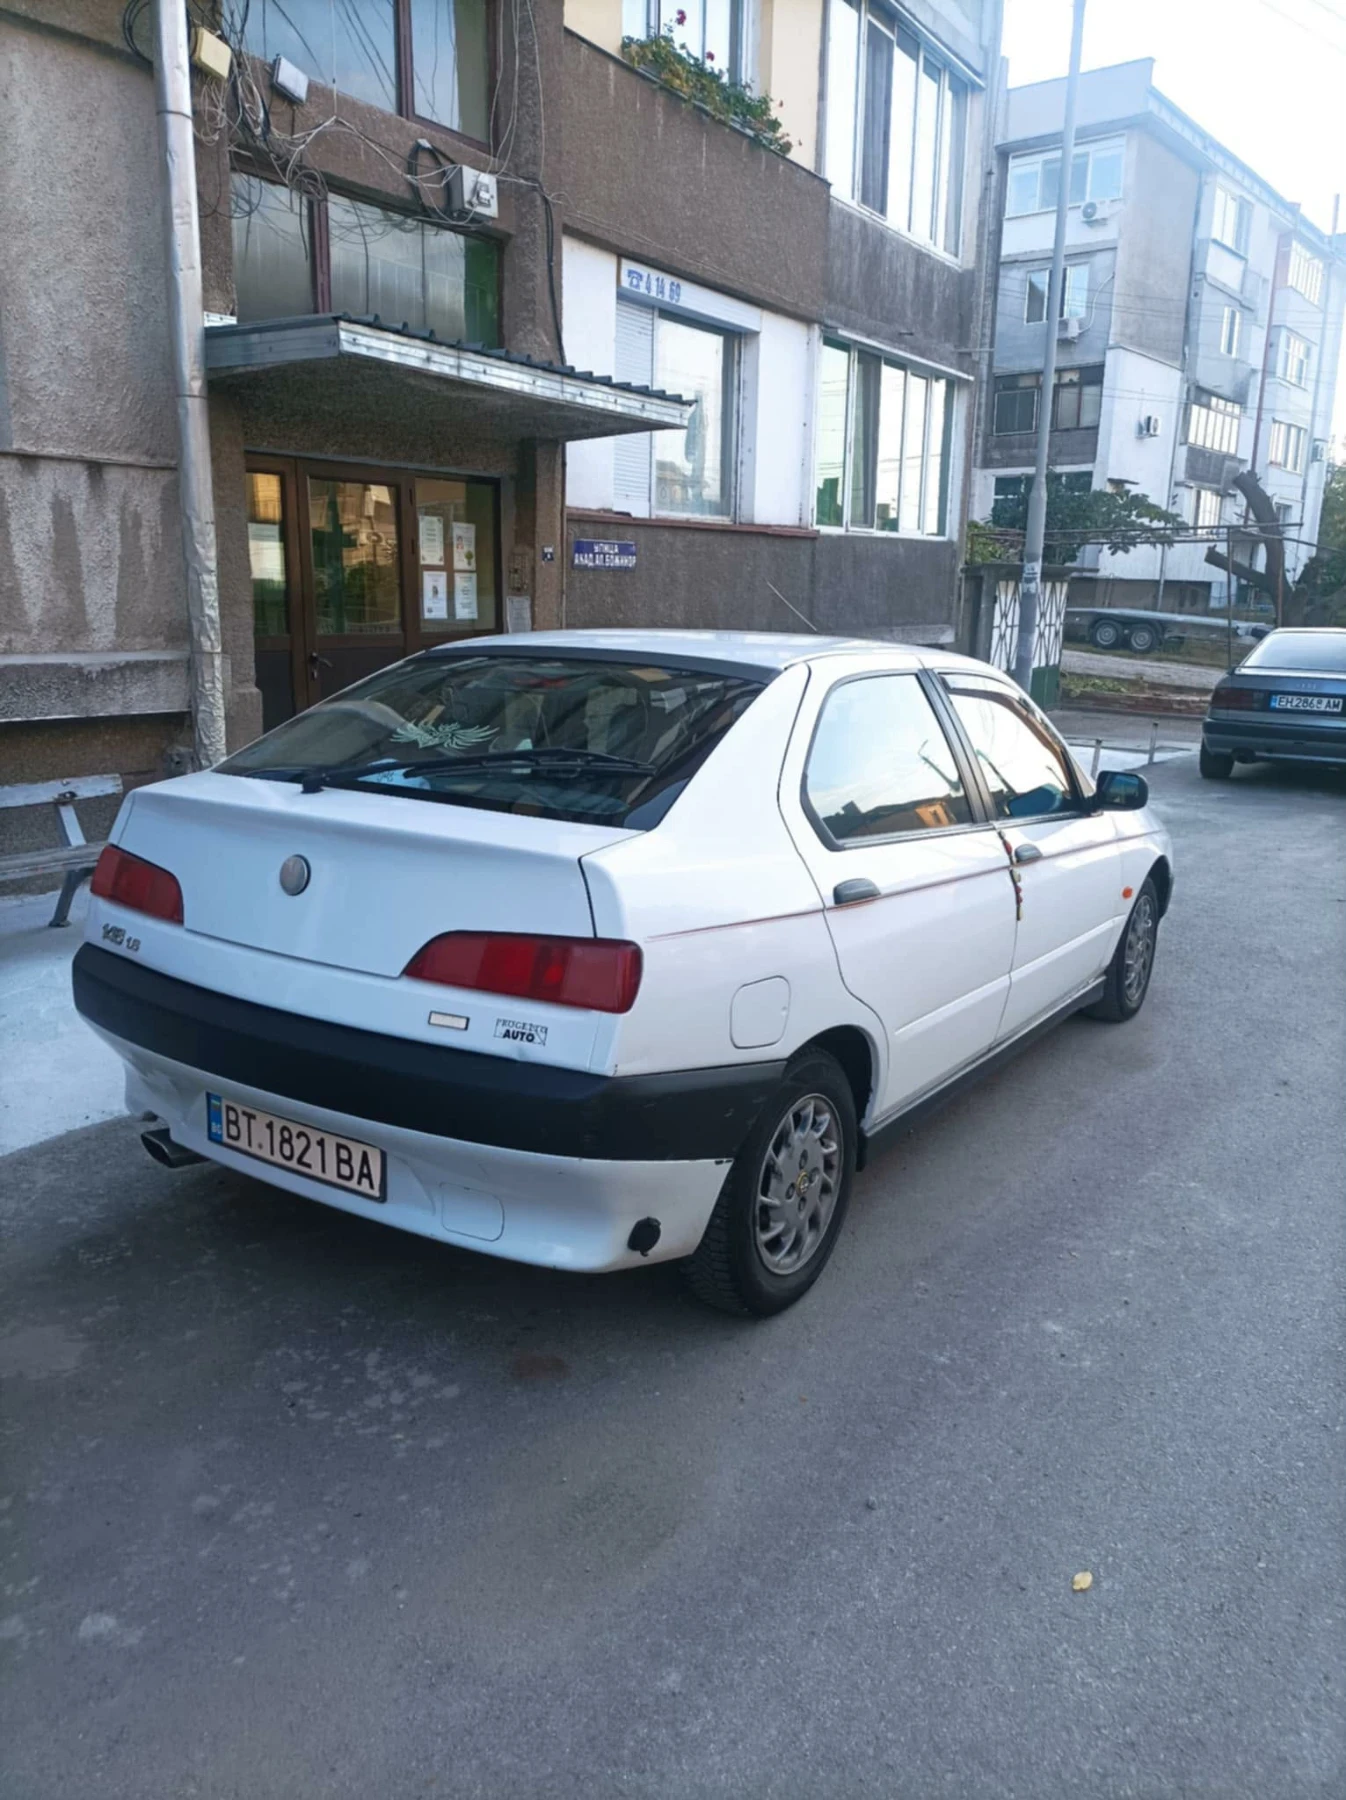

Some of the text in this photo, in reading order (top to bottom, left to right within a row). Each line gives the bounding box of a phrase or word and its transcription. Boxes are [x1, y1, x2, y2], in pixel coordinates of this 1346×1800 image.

[645, 273, 652, 294] 4
[656, 276, 665, 298] 14
[502, 1028, 535, 1043] AUTO
